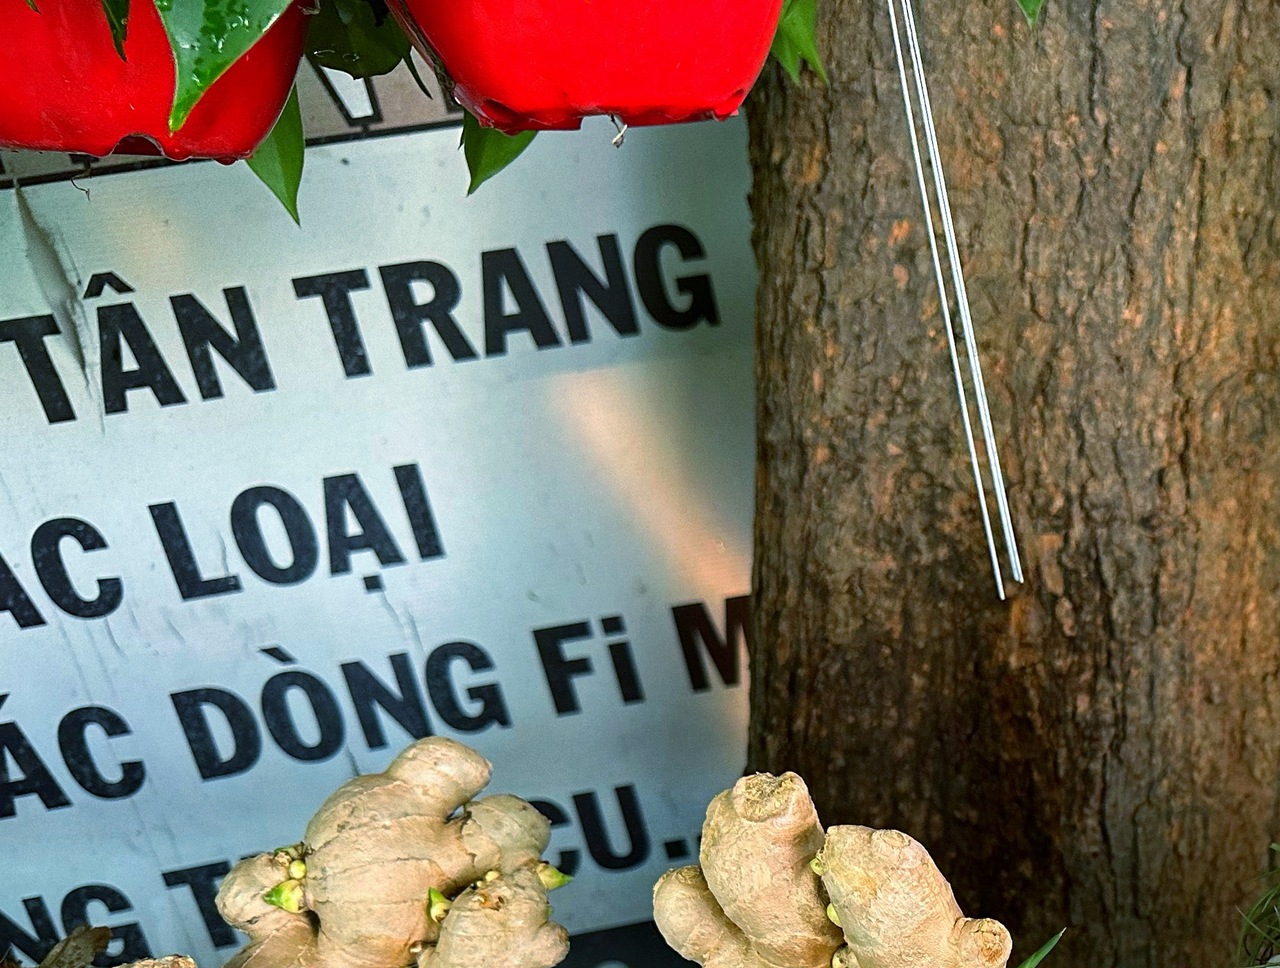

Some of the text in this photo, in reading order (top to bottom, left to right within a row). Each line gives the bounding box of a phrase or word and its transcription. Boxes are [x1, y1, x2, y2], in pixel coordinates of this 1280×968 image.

[0, 224, 722, 424] TÂN TRANG
[148, 463, 447, 599] LOẠI
[170, 641, 512, 780] DÒNG
